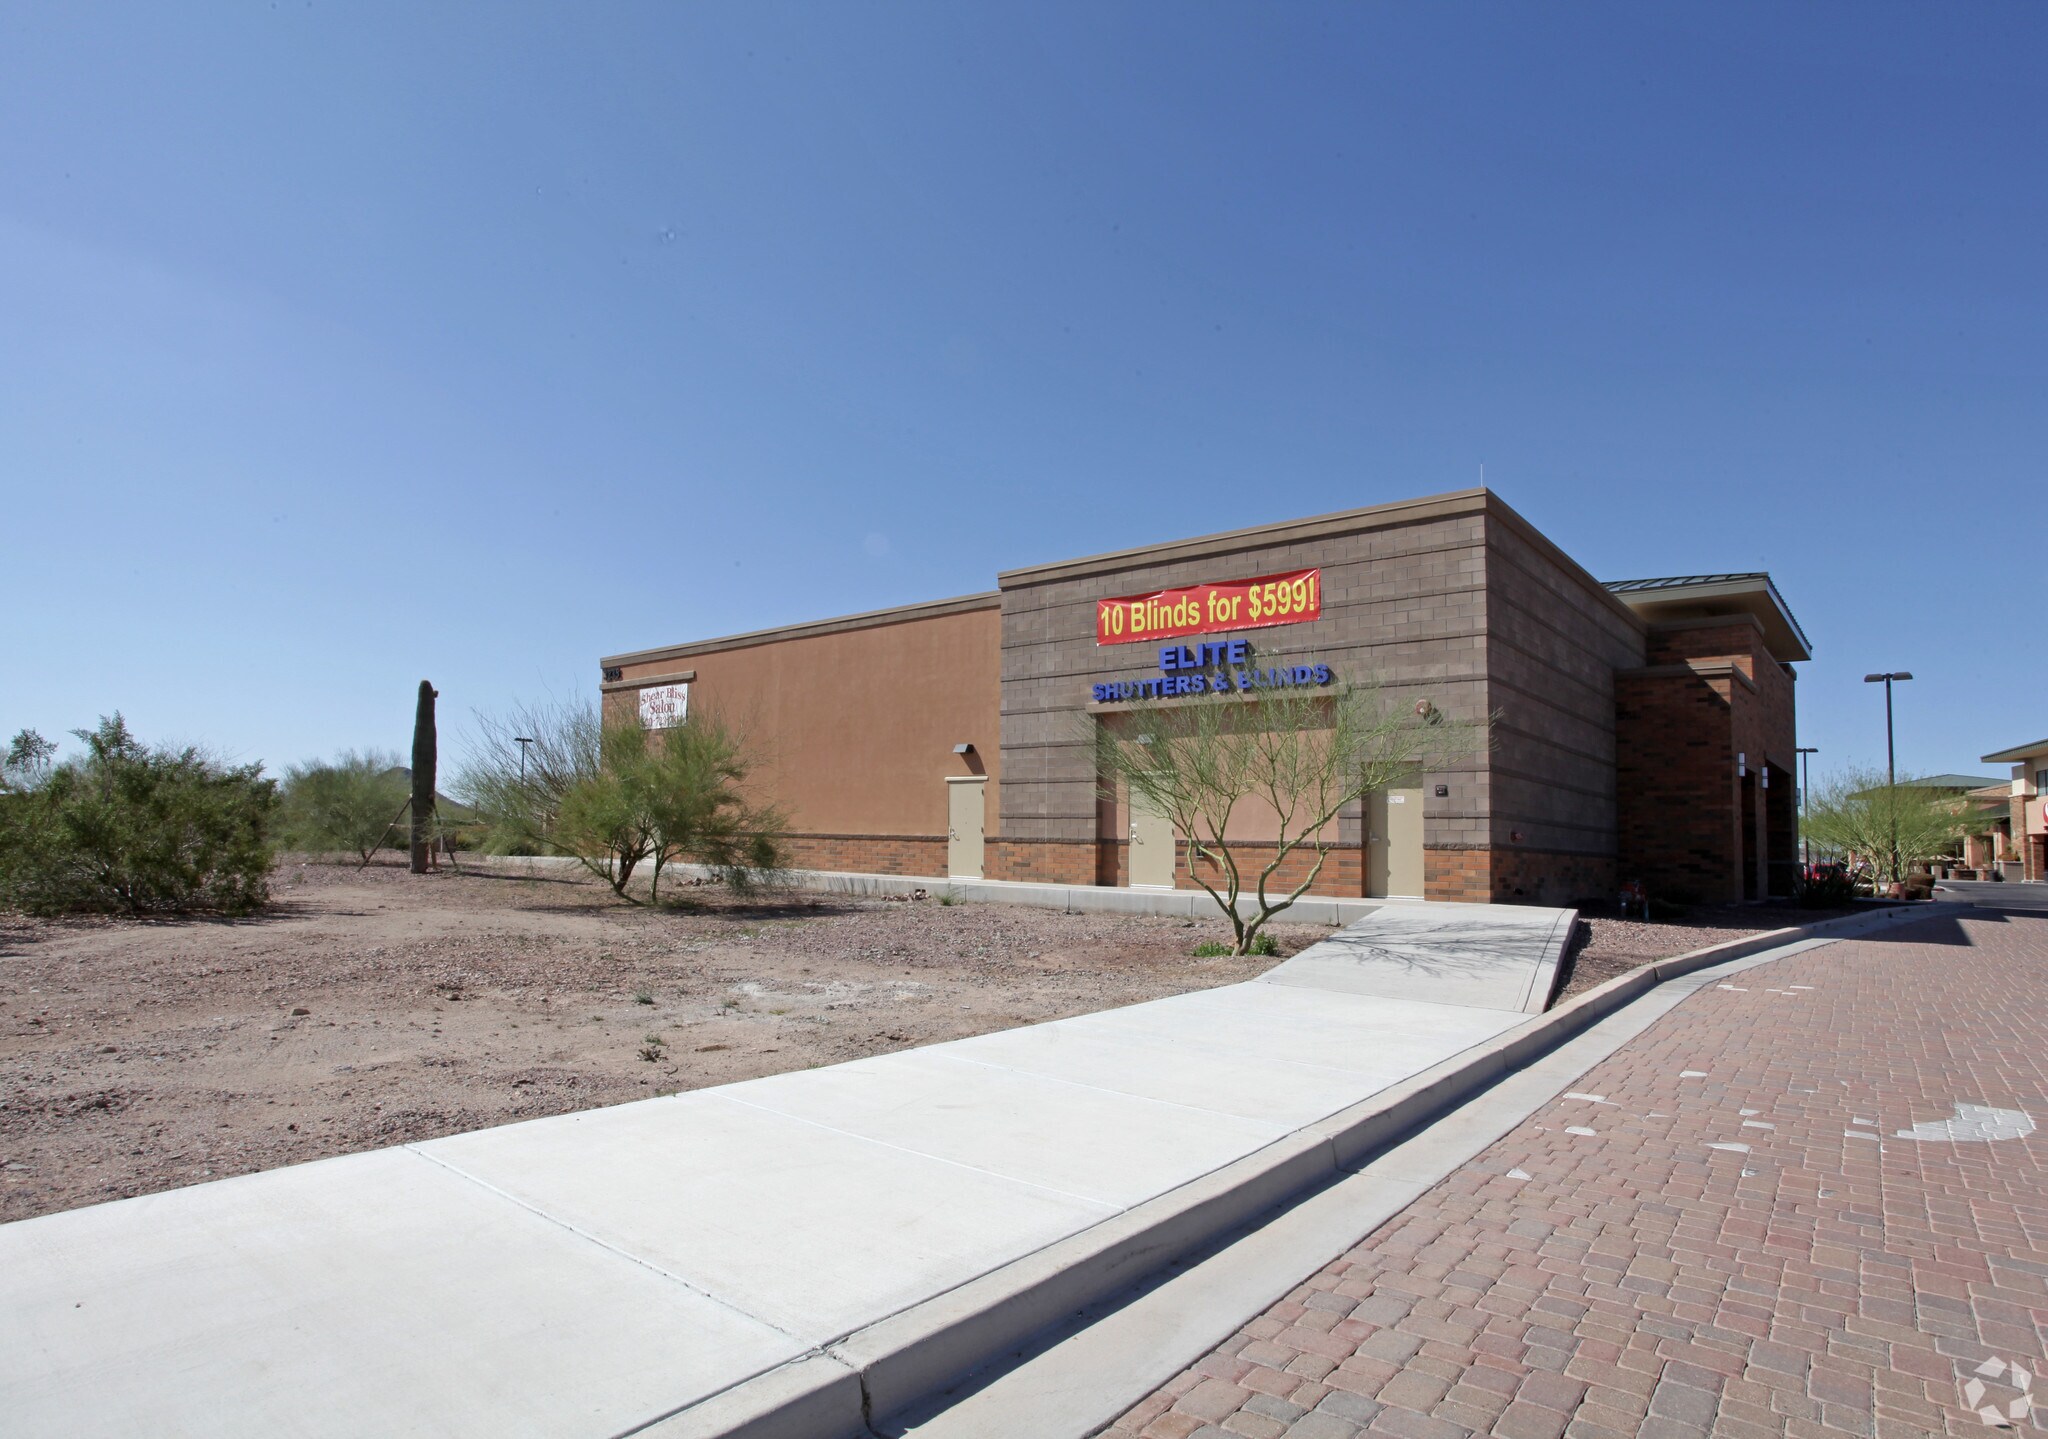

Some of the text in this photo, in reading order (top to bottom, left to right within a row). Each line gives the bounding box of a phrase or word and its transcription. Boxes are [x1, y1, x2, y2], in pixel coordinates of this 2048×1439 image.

[1101, 577, 1315, 636] 10 Blinds for $599!
[1158, 639, 1248, 670] ELITE
[640, 686, 686, 706] Shear Bliss
[1092, 663, 1331, 701] SHUTTERS & BLINDS
[649, 700, 675, 715] Salon
